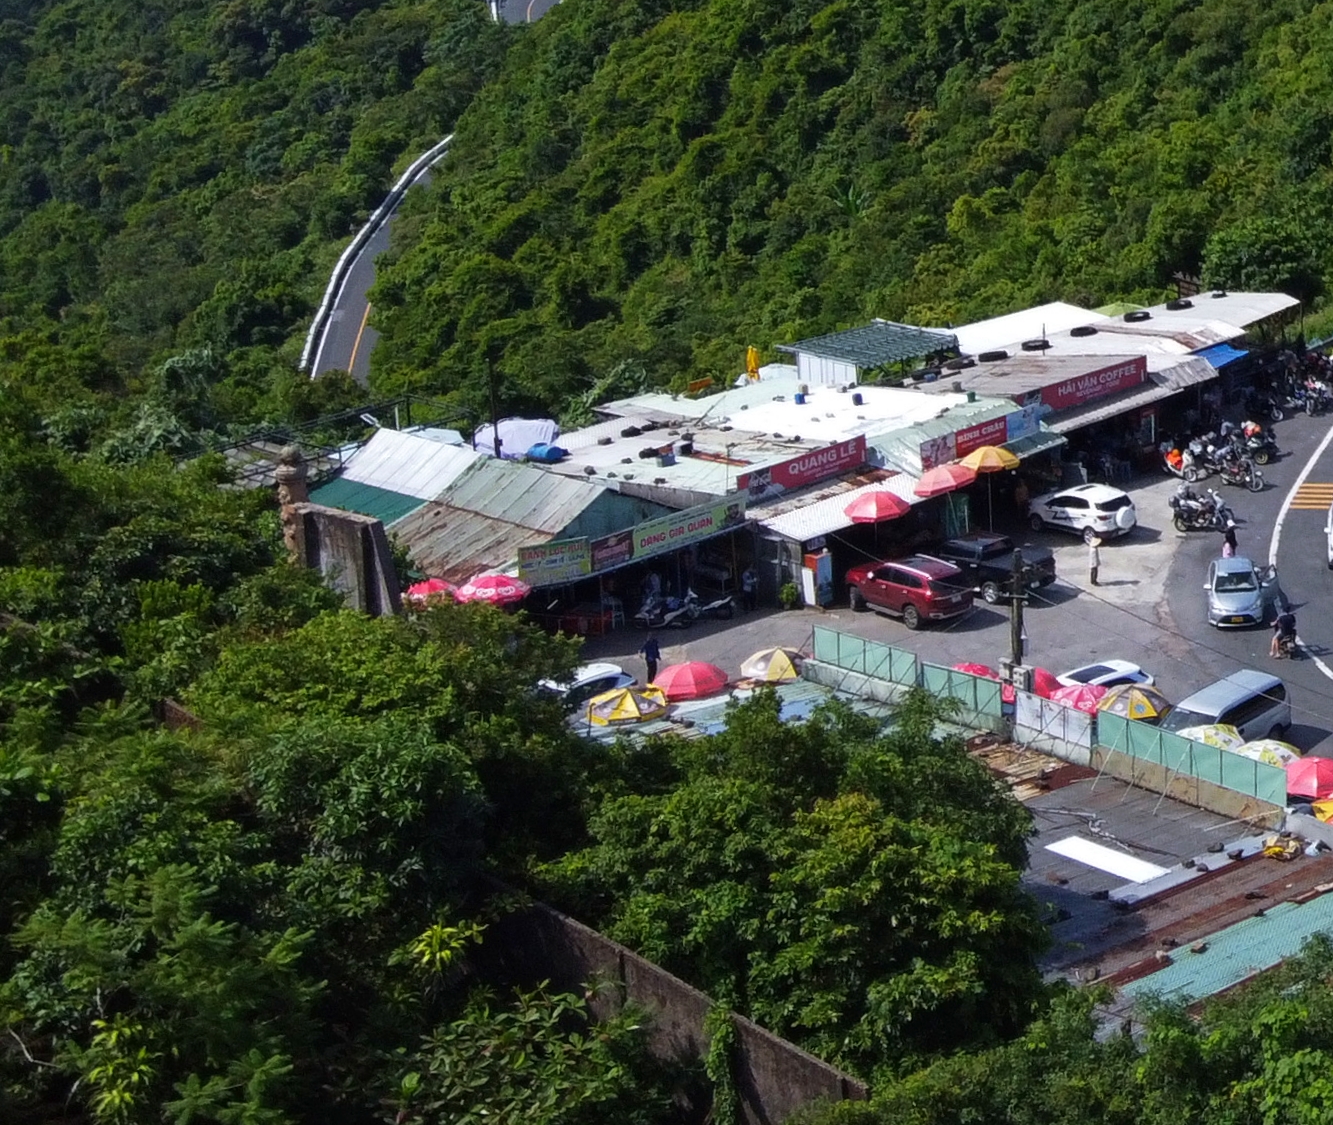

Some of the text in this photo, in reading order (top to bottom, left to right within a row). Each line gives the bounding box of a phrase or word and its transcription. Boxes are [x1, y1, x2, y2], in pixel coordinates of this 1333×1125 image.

[1099, 364, 1137, 384] COFFEE
[788, 449, 837, 475] QUANG
[840, 440, 857, 458] LÊ
